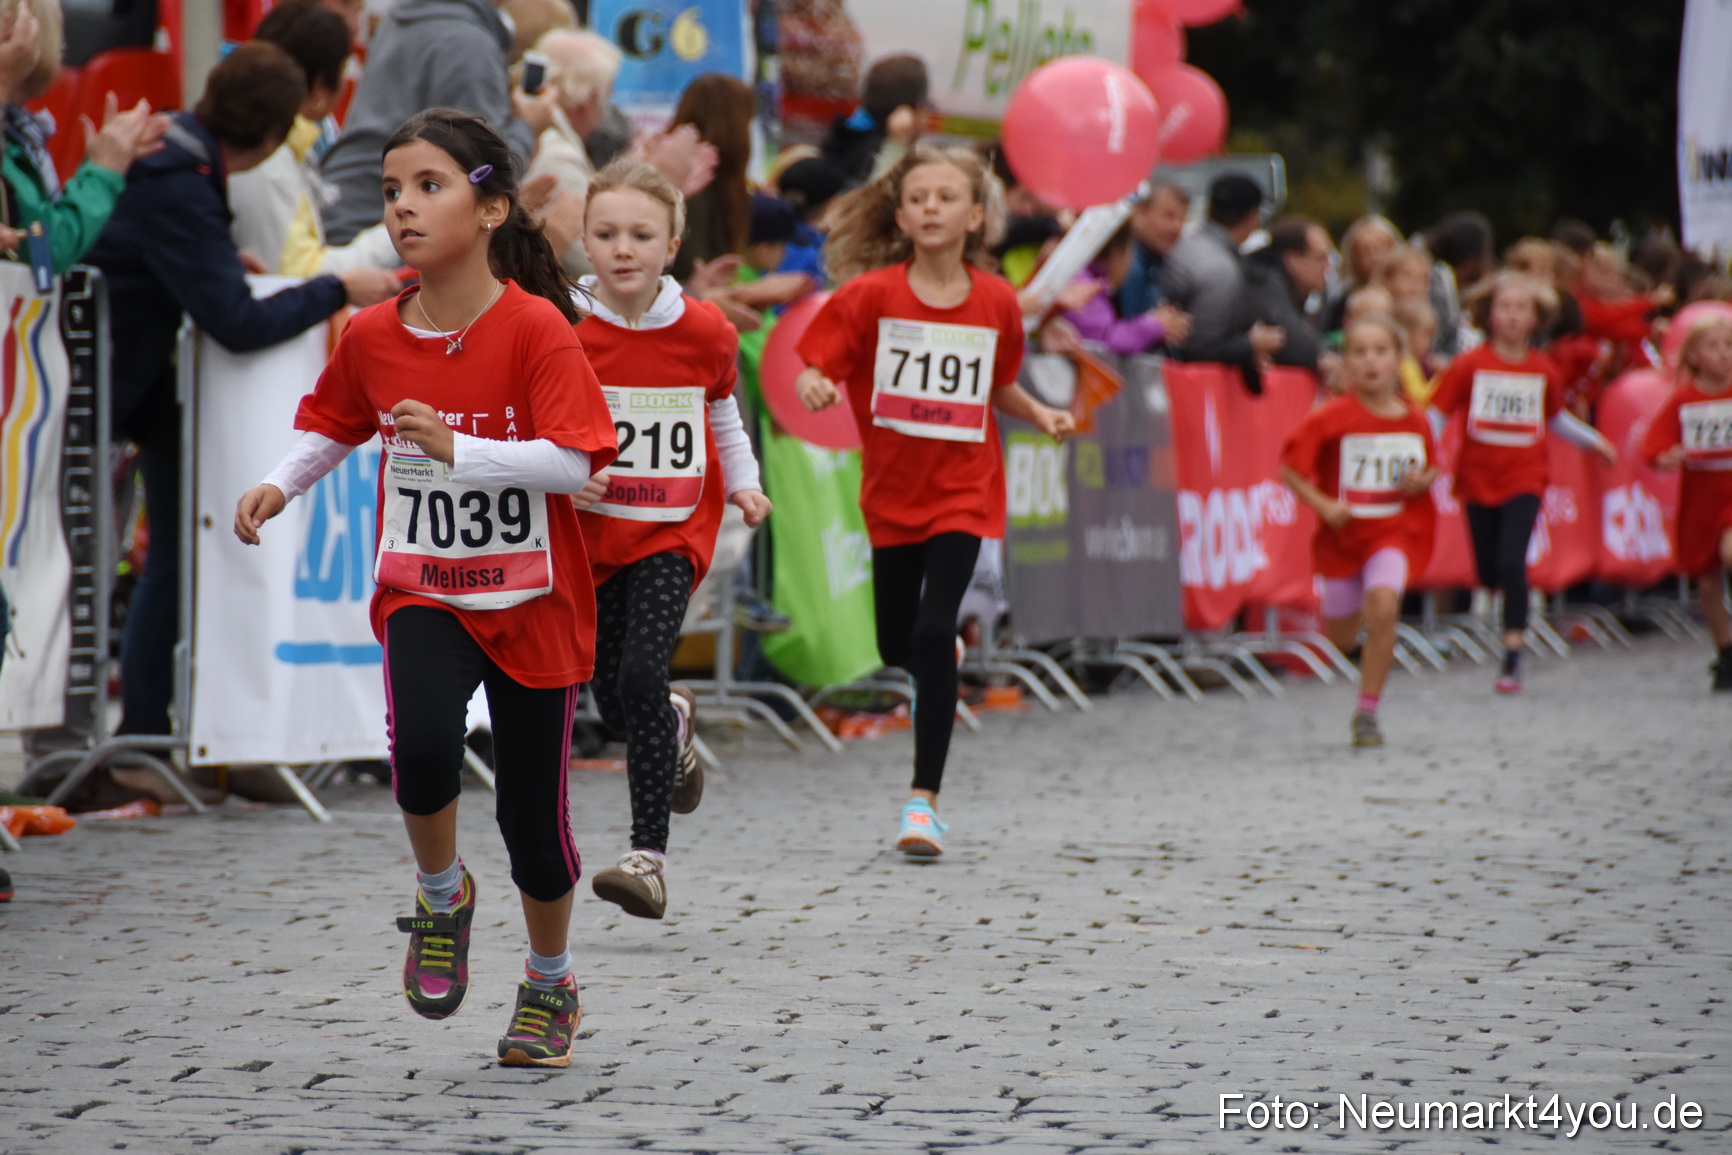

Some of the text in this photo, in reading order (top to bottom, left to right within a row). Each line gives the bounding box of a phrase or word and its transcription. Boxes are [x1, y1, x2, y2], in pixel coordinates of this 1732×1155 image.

[617, 6, 709, 62] G6
[889, 348, 982, 396] 7191
[629, 393, 695, 409] BOCK
[608, 421, 693, 469] 219
[390, 465, 434, 477] NeuerMarkt
[604, 482, 666, 505] Sophia
[397, 487, 531, 549] 7039
[387, 540, 395, 550] 3
[535, 537, 543, 548] K
[420, 563, 504, 588] Melissa
[539, 993, 564, 1007] LICO
